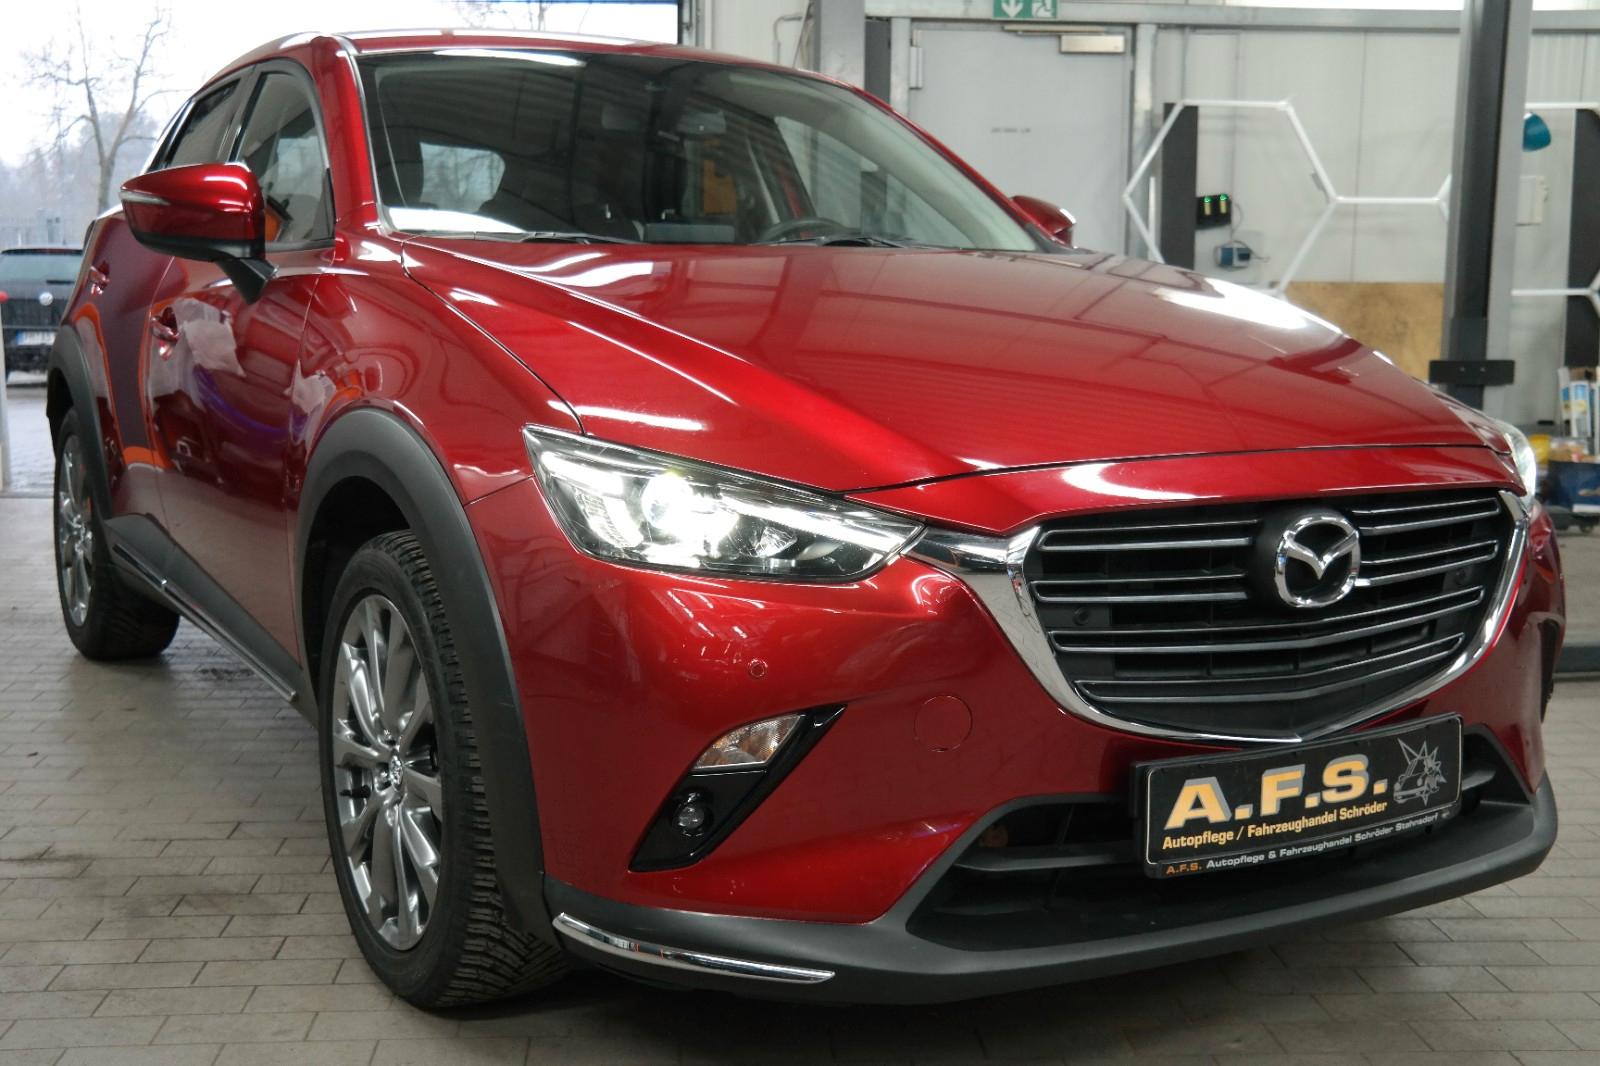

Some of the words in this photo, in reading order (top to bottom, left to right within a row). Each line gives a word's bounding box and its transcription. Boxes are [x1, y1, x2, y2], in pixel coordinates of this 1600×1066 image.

[1163, 754, 1388, 831] A.F.S.
[1162, 829, 1234, 850] Autopflege
[1236, 826, 1245, 840] /
[1247, 812, 1337, 838] Fahrzeughandel
[1339, 801, 1388, 822] Schröder
[1166, 862, 1202, 875] A.F.S.
[1206, 854, 1265, 869] Autopflege
[1268, 850, 1277, 860] &
[1279, 835, 1353, 858] Fahrzeughandel
[1354, 826, 1394, 842] Schröder
[1395, 812, 1438, 831] Stahnsdorf
